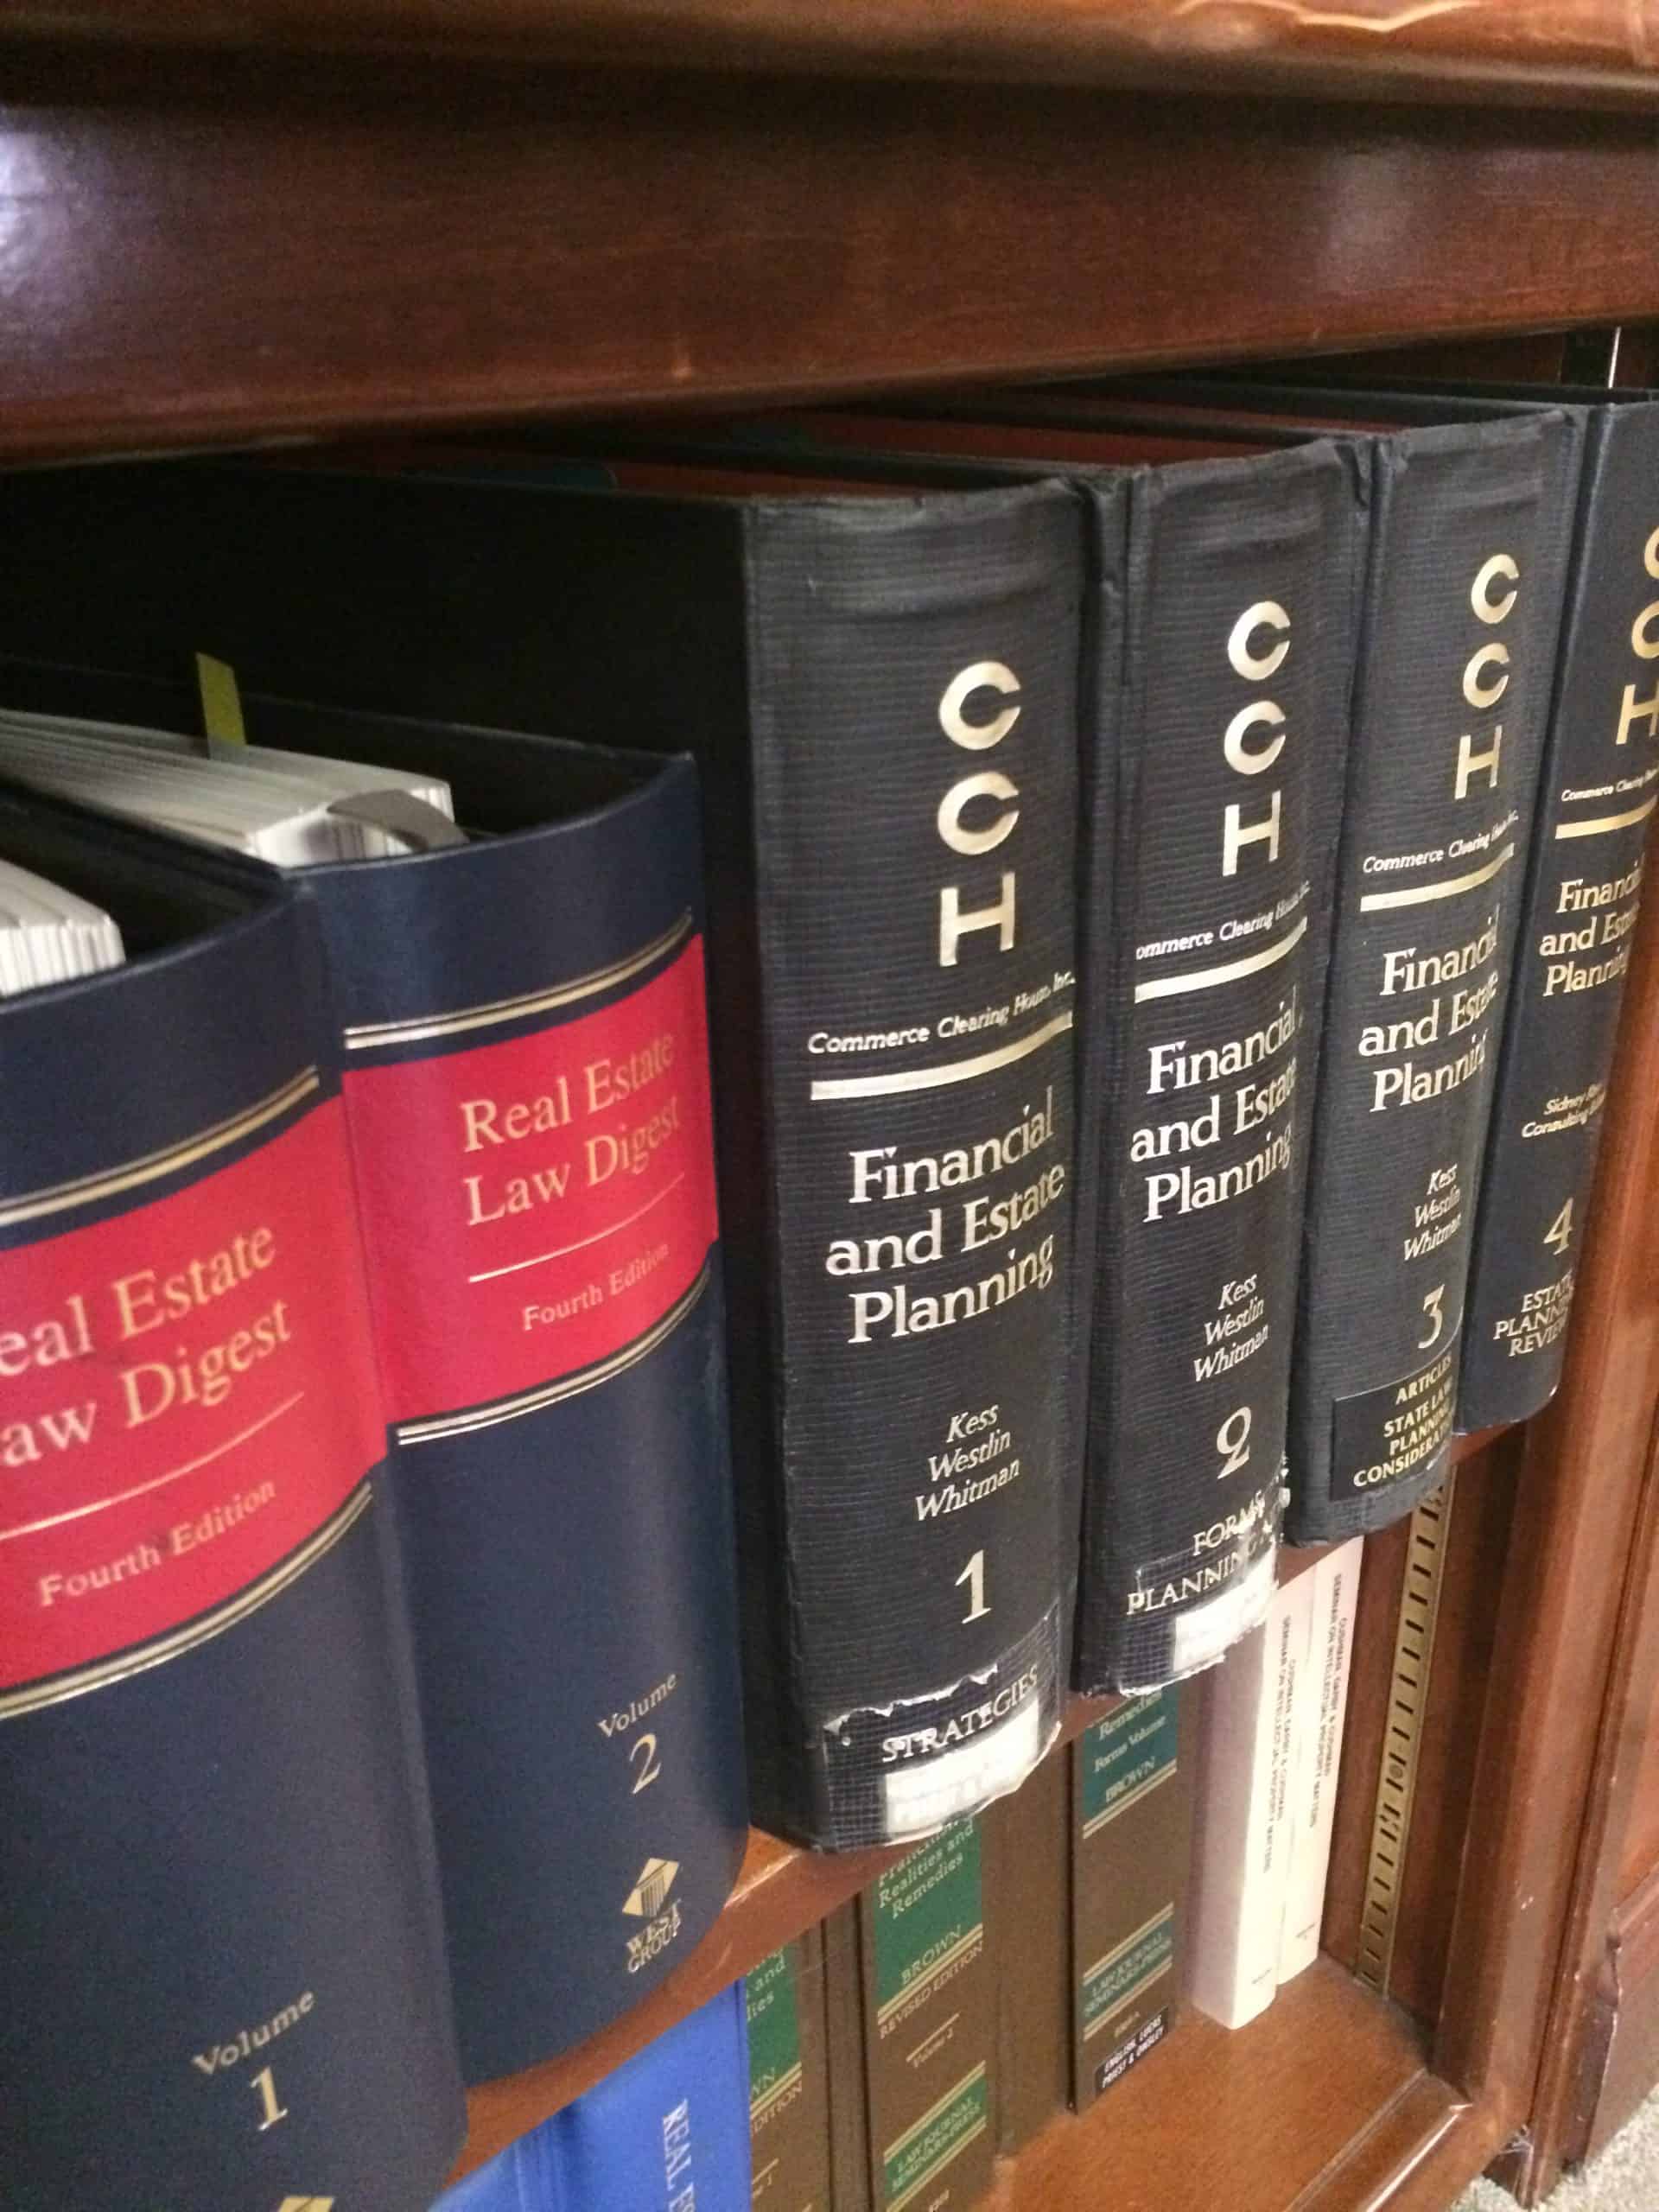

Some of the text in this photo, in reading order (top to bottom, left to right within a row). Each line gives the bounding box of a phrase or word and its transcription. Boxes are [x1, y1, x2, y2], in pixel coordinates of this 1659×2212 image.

[1363, 849, 1444, 873] Commerce
[1135, 931, 1213, 961] ommerce
[1219, 911, 1274, 941] Clearing
[1539, 916, 1598, 957] and
[809, 1027, 929, 1054] Commerce
[938, 1006, 1010, 1039] Clearing
[1147, 982, 1297, 1095] Financial
[1358, 997, 1440, 1058] and
[461, 1031, 675, 1153] Real Estate
[462, 1095, 681, 1226] Law Digest
[849, 1084, 1055, 1204] Financial
[1130, 1094, 1221, 1163] and
[1143, 1122, 1293, 1224] Planning
[825, 1163, 1065, 1276] and Estate
[1543, 1197, 1575, 1256] 4
[0, 1223, 278, 1376] eal Estate
[522, 1239, 671, 1332] Fourth Edition
[848, 1234, 1054, 1344] Planning
[1217, 1274, 1258, 1311] Kess
[1417, 1283, 1446, 1350] 3
[0, 1300, 292, 1467] aw Digest
[1192, 1323, 1269, 1382] Whitman
[945, 1403, 1000, 1444] Kess
[1216, 1406, 1252, 1479] 2
[1383, 1400, 1430, 1439] STATE
[928, 1428, 1012, 1483] Westlin
[915, 1458, 1020, 1522] Whitman
[38, 1479, 277, 1607] Fourth Edition
[955, 1548, 992, 1624] 1
[597, 1673, 677, 1739] Volume
[882, 1663, 1038, 1763] STRATEGIES
[628, 1732, 662, 1795] 2
[1105, 1755, 1156, 1804] BROWN
[947, 1818, 974, 1852] and
[892, 1852, 963, 1920] Remedies
[626, 1897, 682, 1956] WEST
[628, 1916, 682, 1974] GROUP
[901, 1923, 962, 1986] BROWN
[754, 1955, 786, 1992] and
[880, 1940, 982, 2040] REVISED EDITION
[192, 1989, 315, 2076] Volume
[250, 2066, 289, 2132] 1
[752, 2079, 803, 2135] DITION
[662, 2097, 691, 2192] REAL
